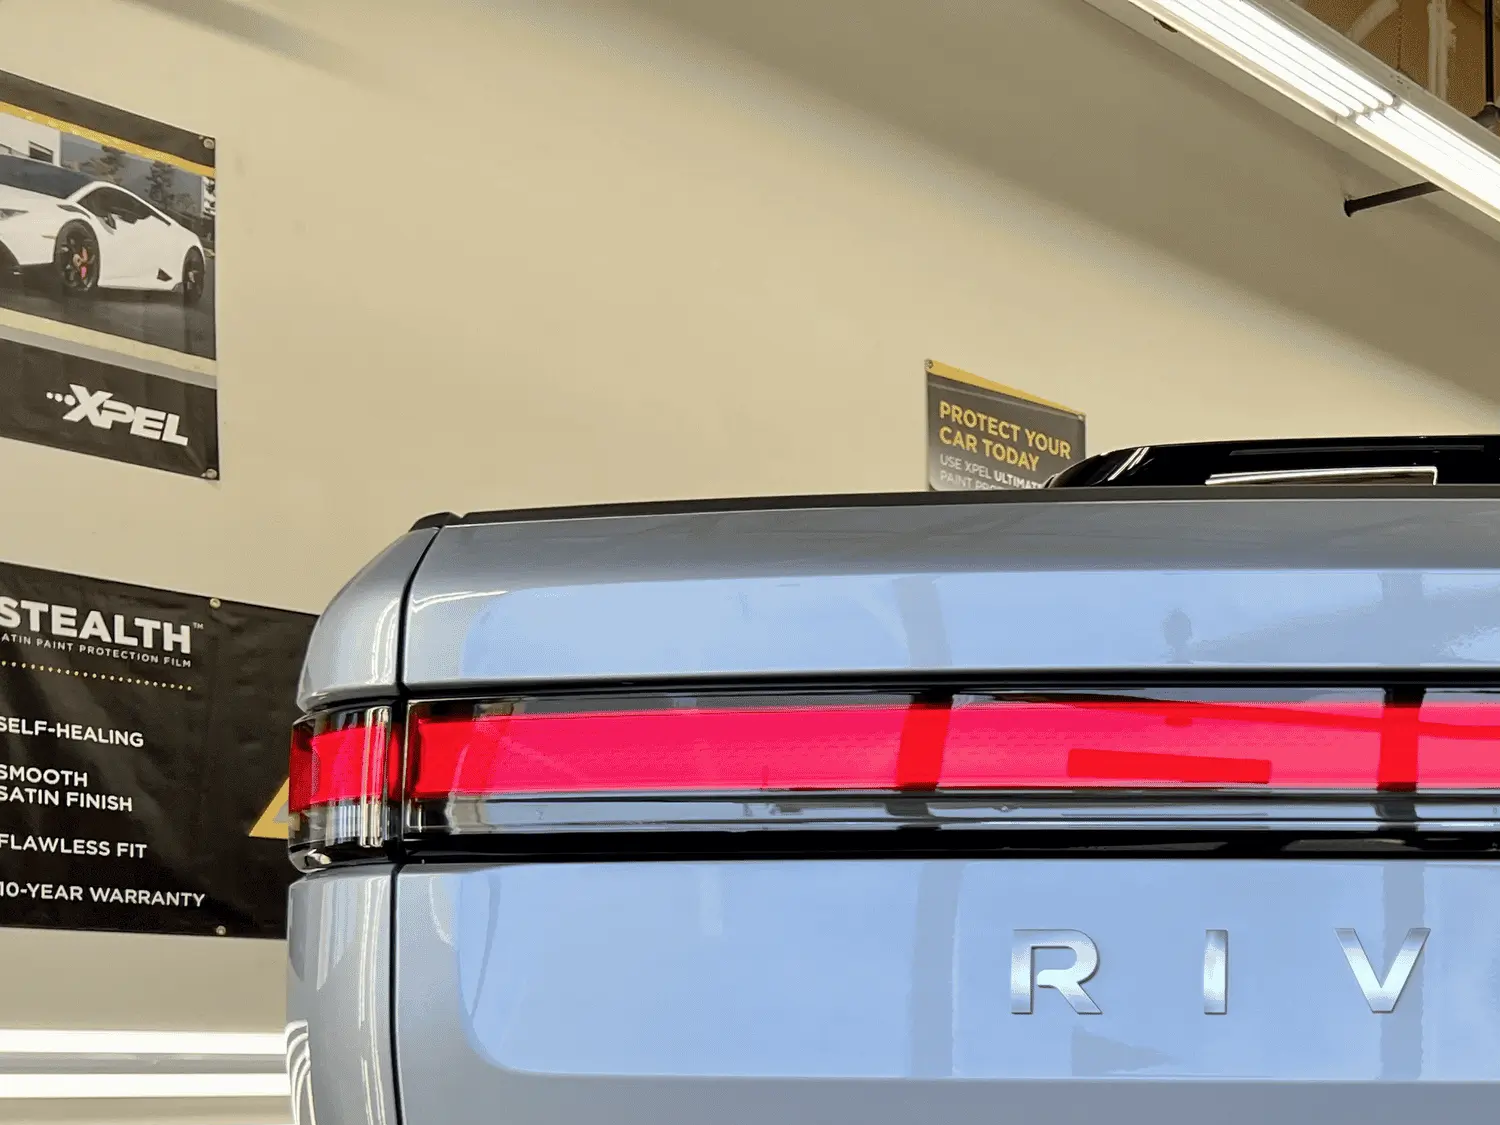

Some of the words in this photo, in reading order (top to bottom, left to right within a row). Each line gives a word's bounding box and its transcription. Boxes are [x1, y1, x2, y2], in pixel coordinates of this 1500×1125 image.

[63, 384, 189, 446] XPEL
[939, 400, 1020, 442] PROTECT
[1025, 428, 1071, 459] YOUR
[939, 426, 977, 453] CAR
[982, 438, 1039, 471] TODAY
[940, 453, 961, 470] USE
[965, 460, 992, 480] XPEL
[940, 470, 973, 488] PAINT
[0, 596, 191, 654] STEALTH
[1, 633, 31, 646] ATIN
[36, 638, 74, 652] PAINT
[79, 644, 159, 664] PROTECTION
[163, 656, 191, 668] FILM
[0, 716, 144, 748] SELF-HEALING
[0, 764, 88, 788] SMOOTH
[0, 785, 59, 806] SATIN
[66, 791, 133, 812] FINISH
[0, 833, 110, 857] FLAWLESS
[117, 842, 147, 859] FIT
[90, 886, 205, 907] WARRANTY
